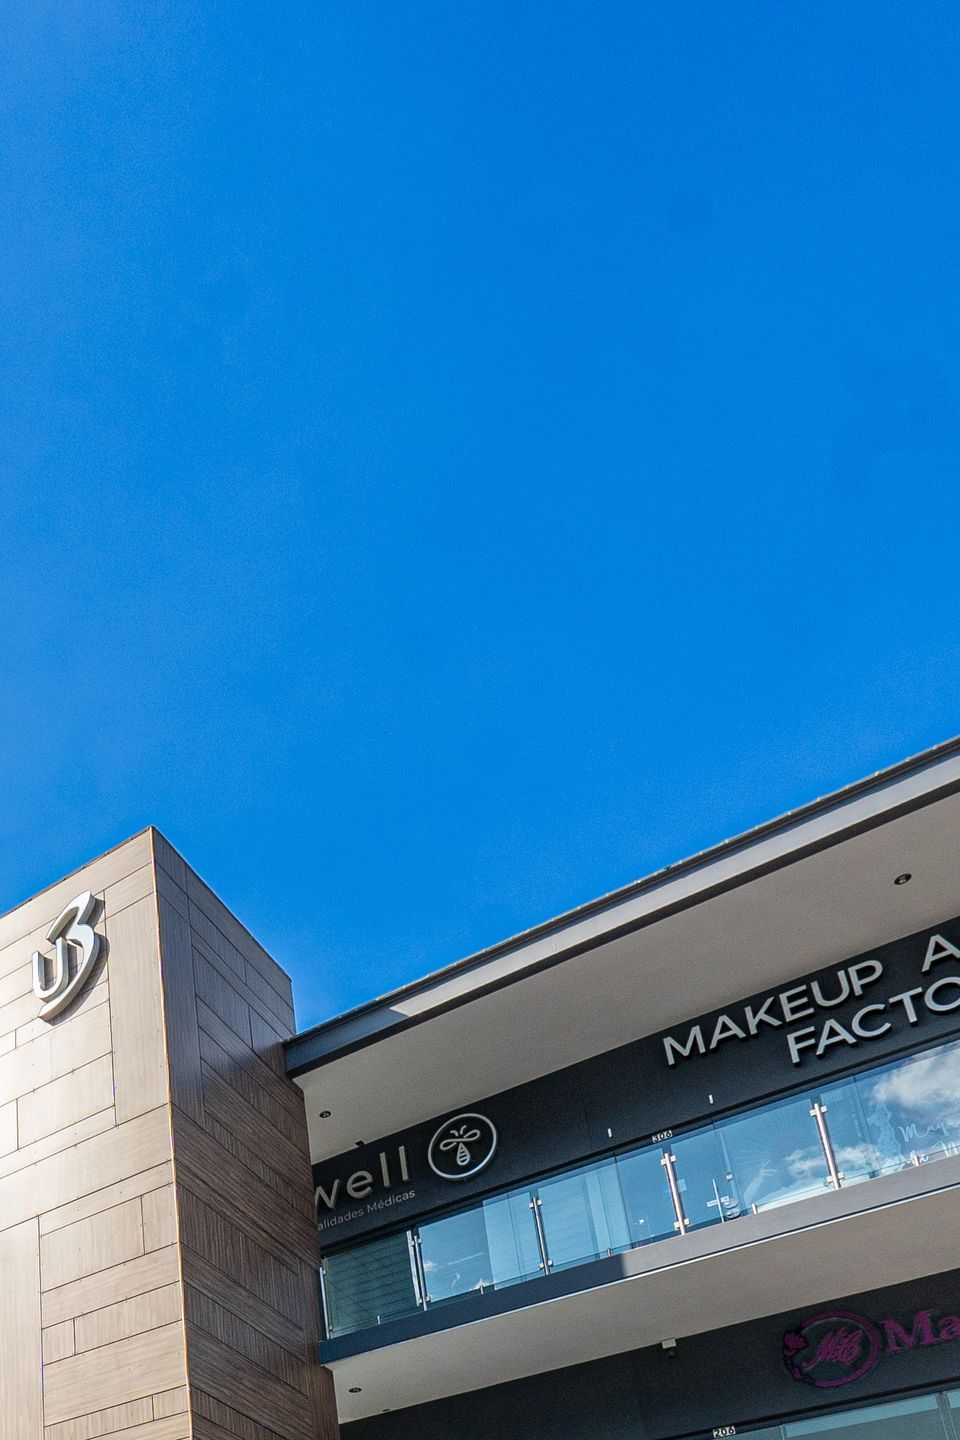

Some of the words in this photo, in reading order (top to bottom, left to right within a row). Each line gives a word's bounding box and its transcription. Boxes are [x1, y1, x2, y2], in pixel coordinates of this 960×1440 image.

[663, 959, 883, 1066] MAKEUP
[786, 976, 960, 1065] FACTO
[366, 1189, 417, 1215] Médicas
[713, 1426, 737, 1438] 206
